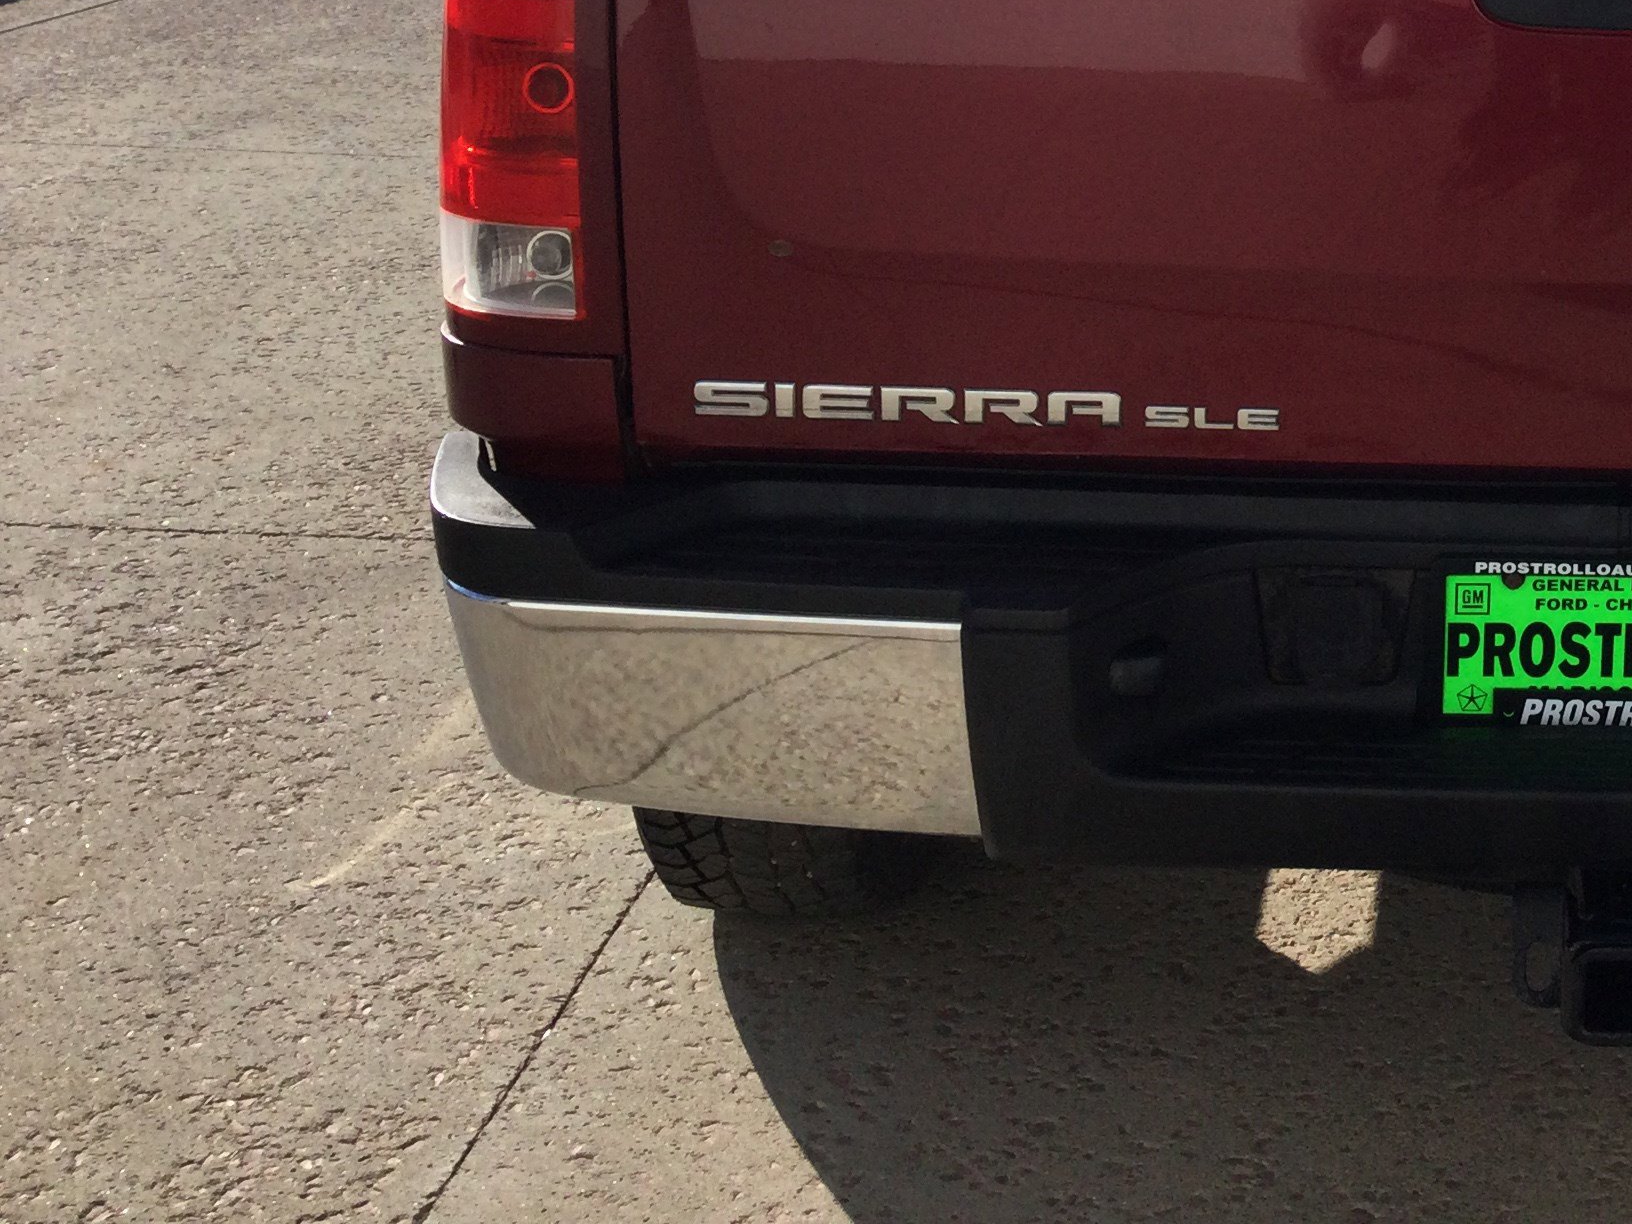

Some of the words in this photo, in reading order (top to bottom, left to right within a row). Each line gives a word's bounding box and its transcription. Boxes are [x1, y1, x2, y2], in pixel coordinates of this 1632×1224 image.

[693, 380, 1123, 428] SIERRA
[1144, 405, 1280, 431] SLE
[1531, 578, 1625, 593] GENERAL
[1461, 588, 1485, 605] GM
[1534, 597, 1589, 611] FORD
